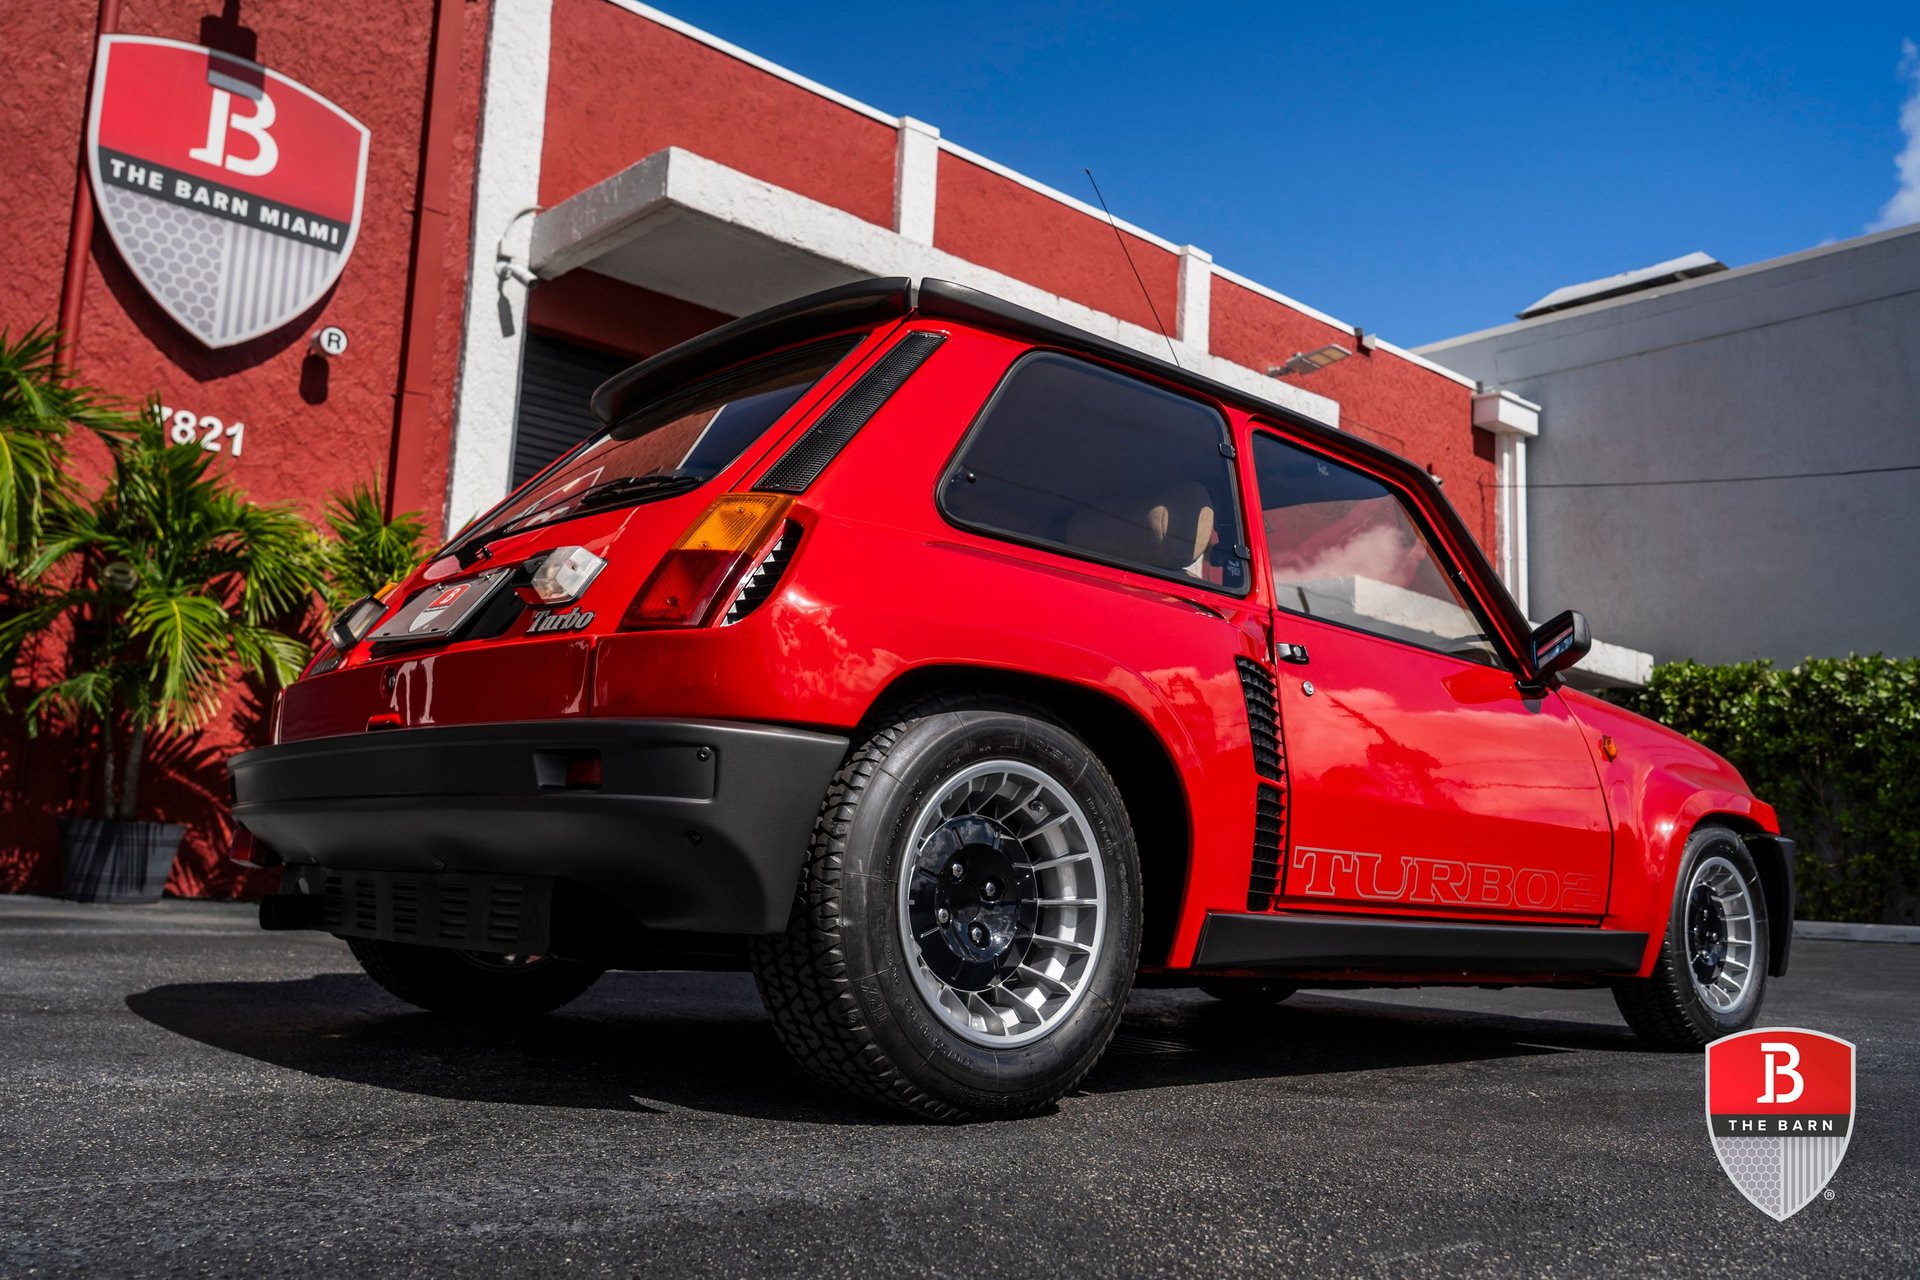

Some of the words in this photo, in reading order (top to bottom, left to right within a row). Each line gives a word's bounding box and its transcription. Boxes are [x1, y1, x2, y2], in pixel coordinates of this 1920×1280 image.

[189, 69, 279, 177] B
[110, 158, 164, 191] THE
[174, 179, 249, 217] BARN
[259, 205, 339, 245] MIAMI
[525, 607, 595, 633] Turbo
